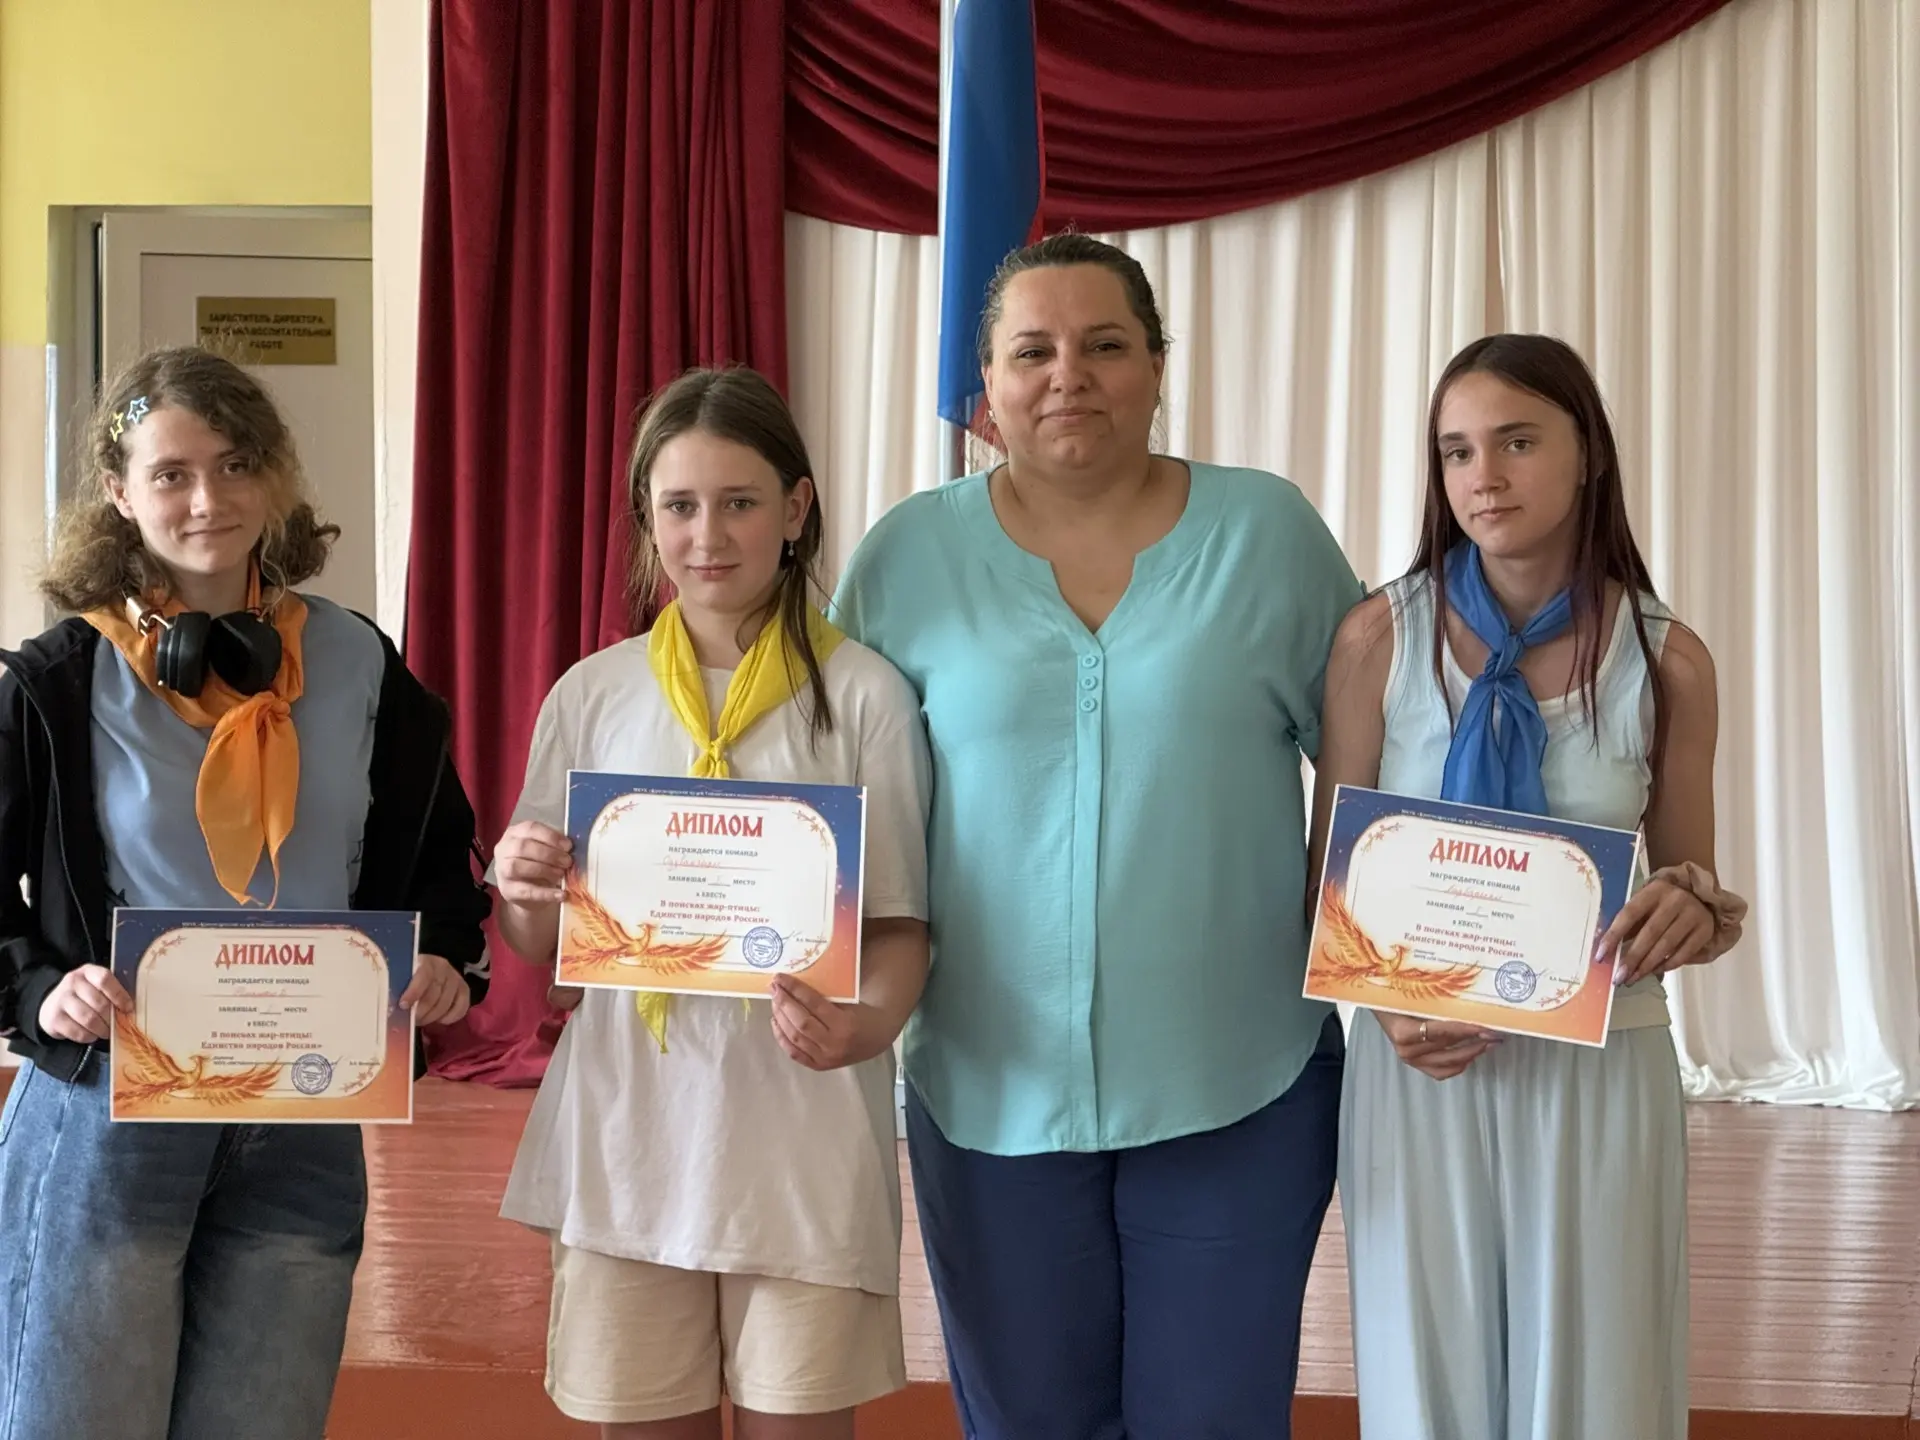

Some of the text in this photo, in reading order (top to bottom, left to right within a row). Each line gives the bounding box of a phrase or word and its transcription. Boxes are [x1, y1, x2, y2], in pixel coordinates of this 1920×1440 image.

[272, 314, 325, 324] ДИРЕКТОРА
[665, 811, 764, 840] ДИПЛОМ
[668, 846, 758, 857] награждается команда
[1428, 837, 1531, 873] ДИПЛОМ
[1430, 871, 1520, 892] награждается команда
[668, 901, 705, 909] поисках
[650, 910, 692, 919] Единство
[694, 913, 731, 922] народов
[1491, 911, 1515, 919] место
[1423, 926, 1460, 938] поисках
[1404, 932, 1446, 946] Единство
[1448, 940, 1486, 952] народов
[214, 943, 315, 970] ДИПЛОМ
[201, 1042, 244, 1050] Единство
[246, 1043, 284, 1051] народов
